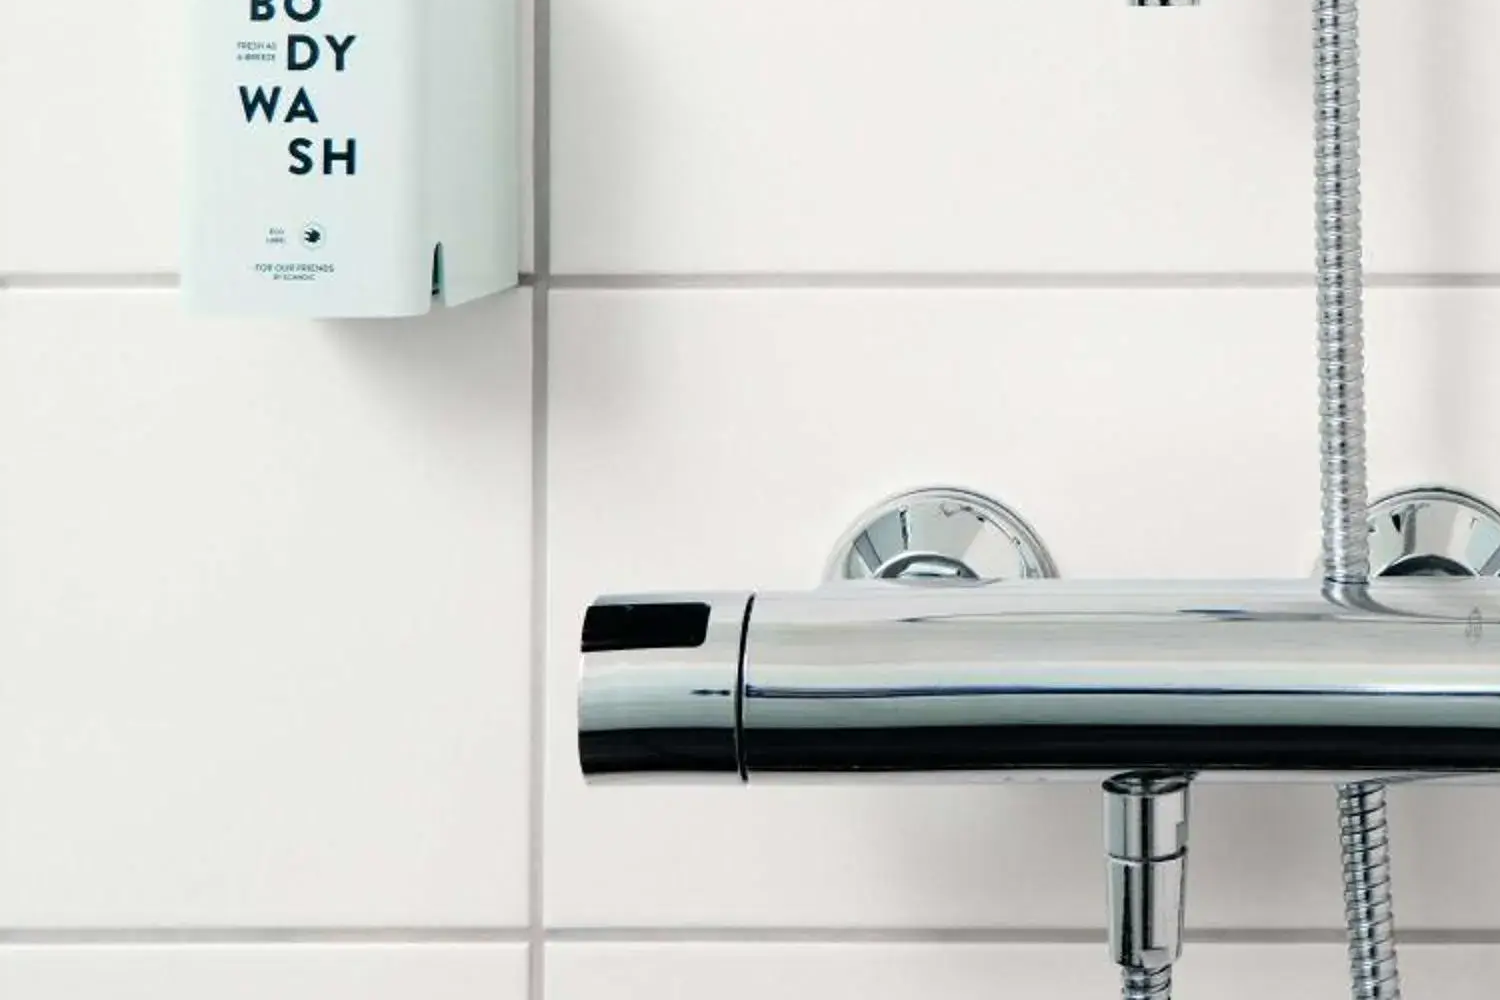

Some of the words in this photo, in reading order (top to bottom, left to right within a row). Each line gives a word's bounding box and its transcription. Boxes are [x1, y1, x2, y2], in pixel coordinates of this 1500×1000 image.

[287, 34, 356, 71] DY
[239, 86, 319, 123] WA
[288, 138, 356, 175] SH
